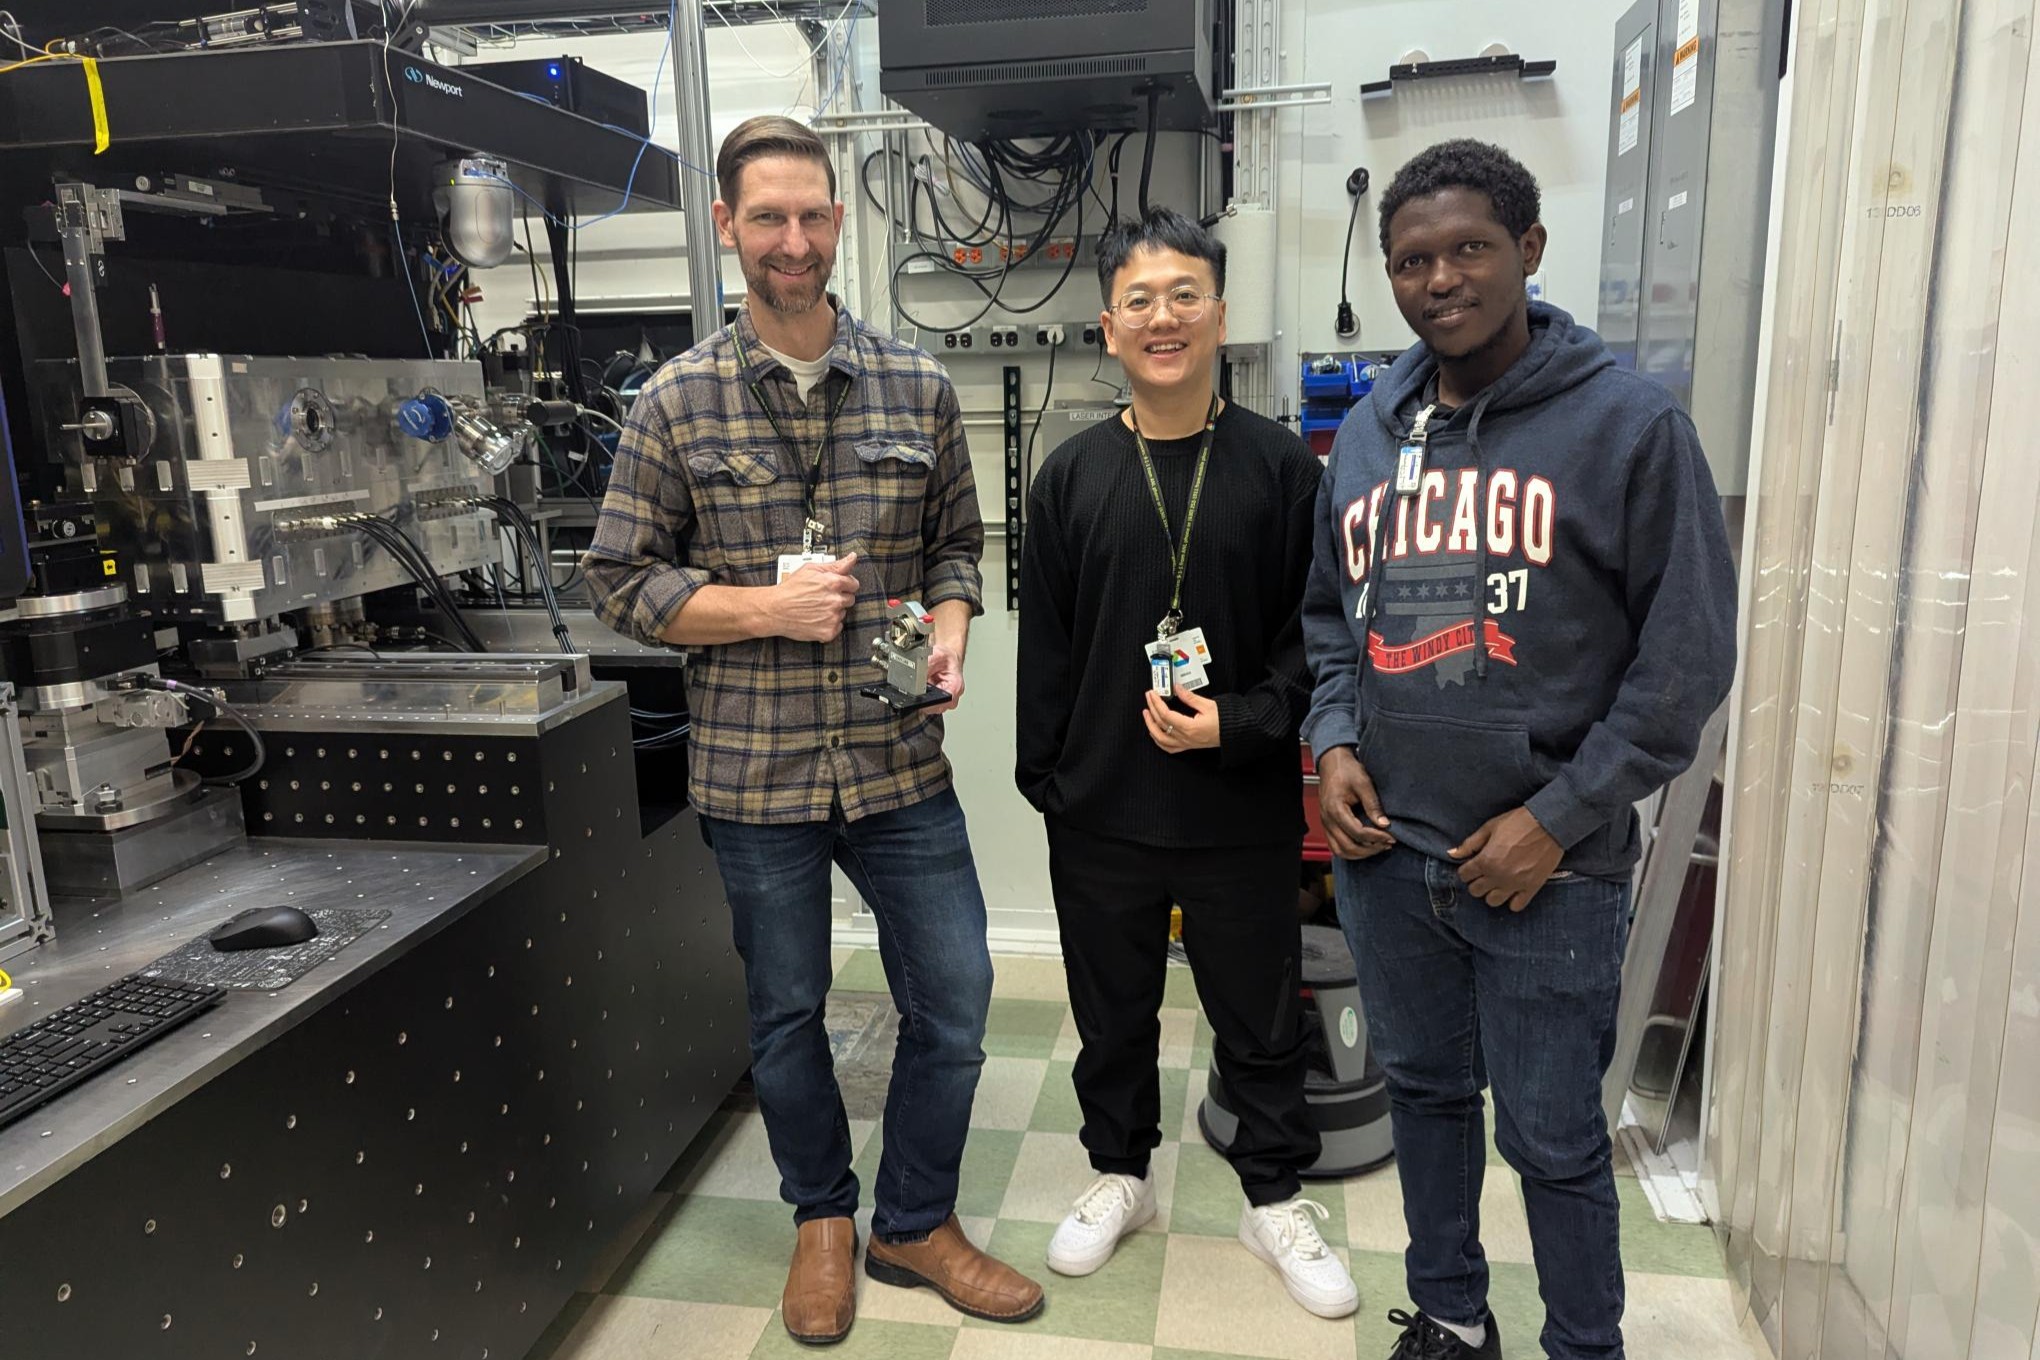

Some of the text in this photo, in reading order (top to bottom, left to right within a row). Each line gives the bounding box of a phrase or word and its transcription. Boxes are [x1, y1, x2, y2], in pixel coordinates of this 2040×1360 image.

[425, 73, 463, 97] Newport
[1487, 569, 1528, 614] 37
[1386, 623, 1476, 669] THE WINDY CIT
